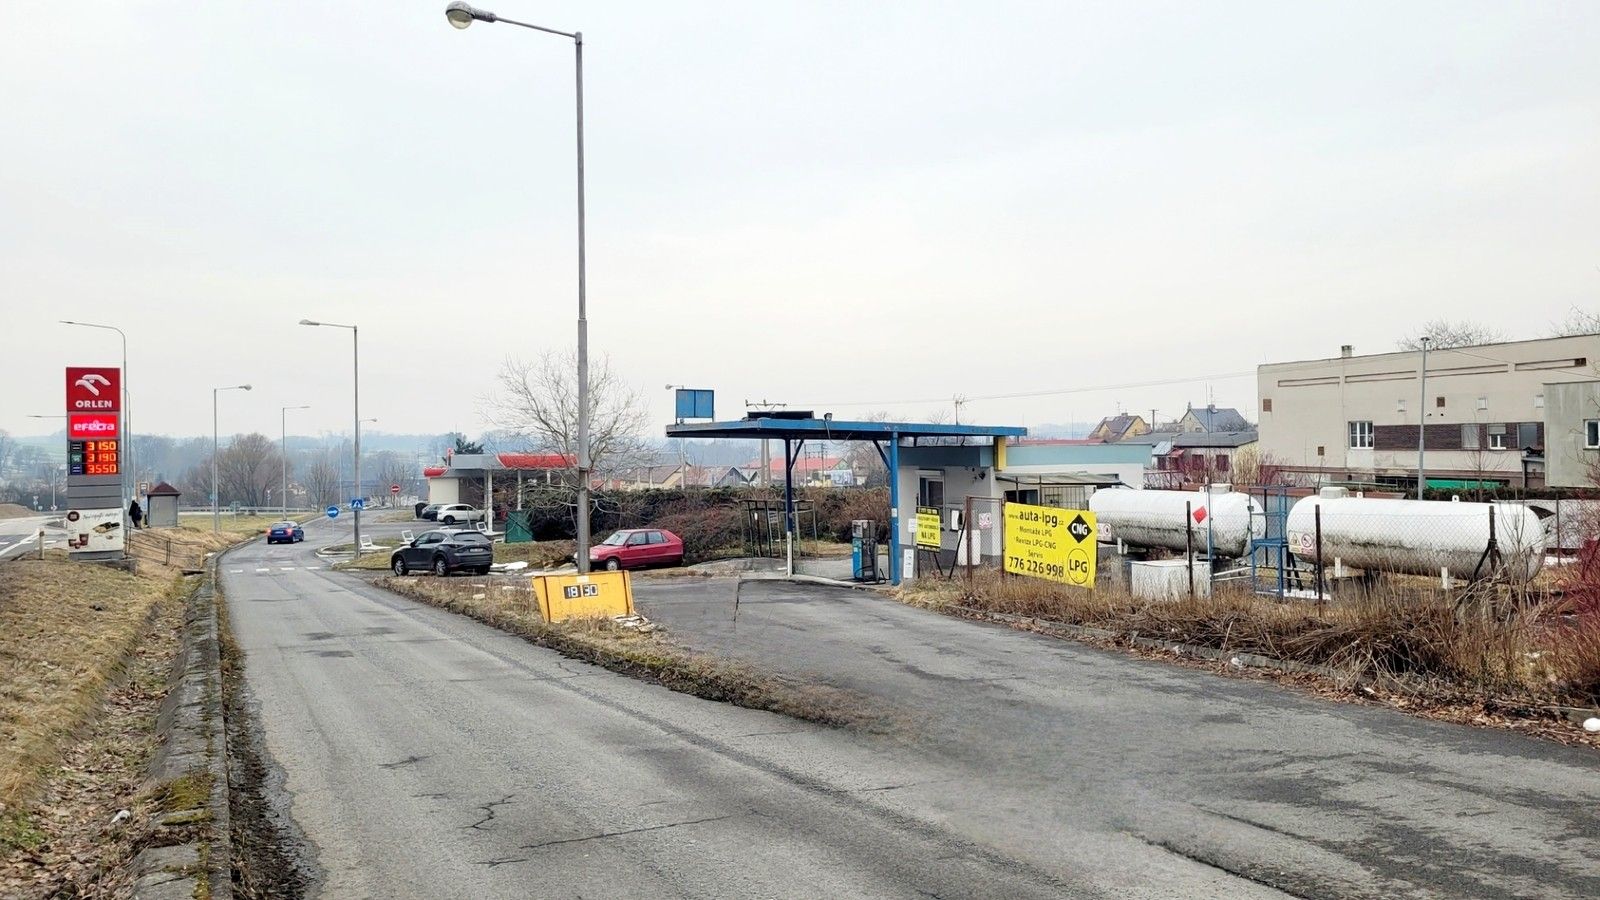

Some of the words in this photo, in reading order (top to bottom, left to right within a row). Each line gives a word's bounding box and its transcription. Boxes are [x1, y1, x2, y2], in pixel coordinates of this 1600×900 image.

[75, 400, 112, 408] ORLEN
[1041, 530, 1053, 538] LPG
[1071, 522, 1088, 536] CNG
[1009, 556, 1025, 571] 776
[1027, 559, 1044, 574] 226
[1046, 563, 1064, 578] 998
[1069, 558, 1088, 573] LPG
[567, 585, 579, 598] 18
[583, 584, 597, 597] 30
